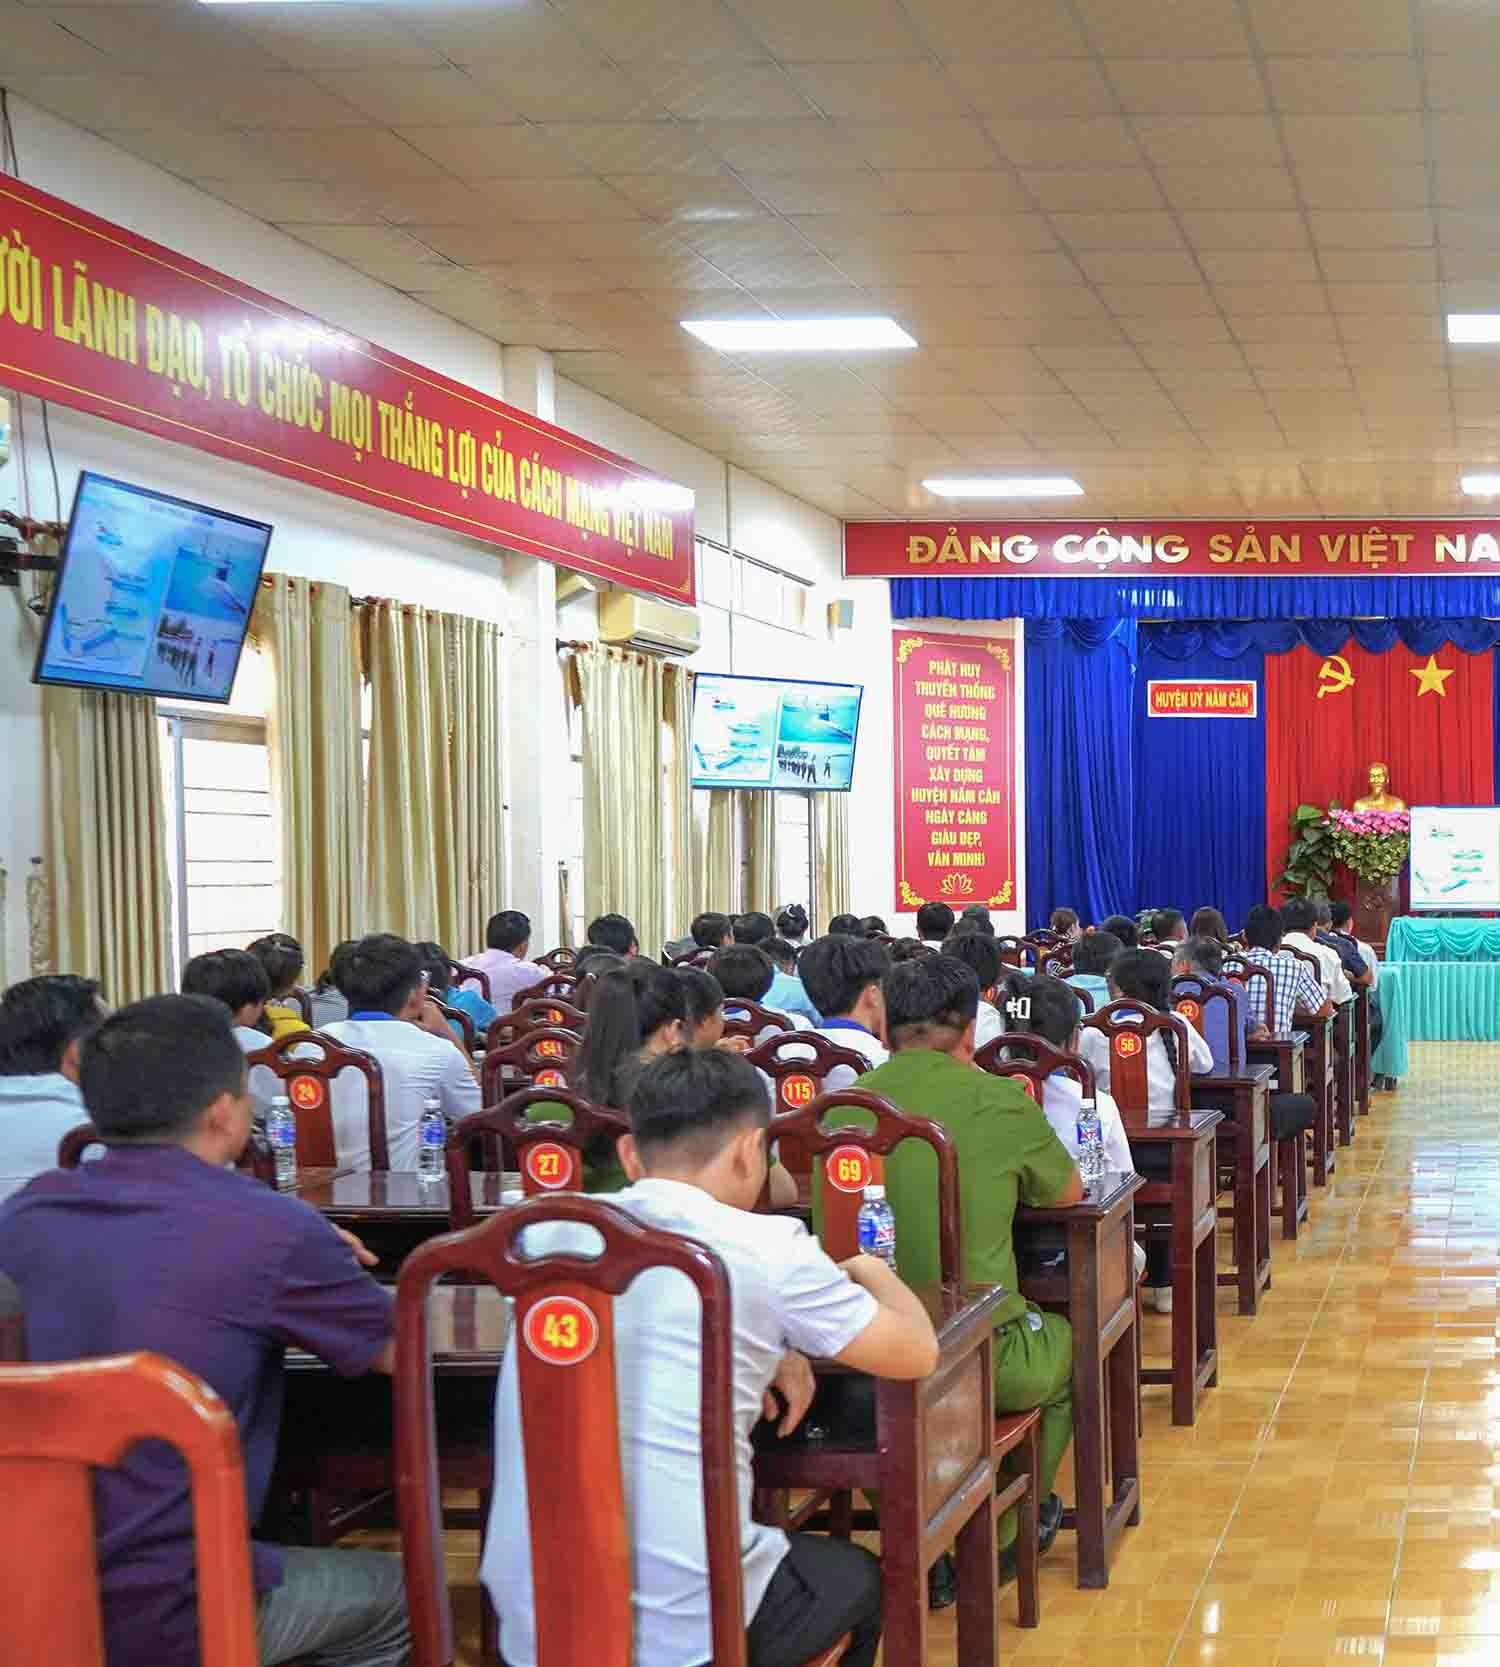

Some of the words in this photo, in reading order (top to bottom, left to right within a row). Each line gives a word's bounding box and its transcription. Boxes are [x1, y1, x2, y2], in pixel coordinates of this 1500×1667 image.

[53, 260, 138, 365] LÃNH
[146, 304, 210, 400] ĐẠO,
[256, 352, 323, 432] CHỨC
[330, 381, 373, 461] MỌI
[378, 392, 443, 477] THẮNG
[448, 428, 477, 498] LỢI
[482, 430, 516, 503] CỦA
[520, 453, 561, 519] CÁCH
[643, 509, 673, 561] NAM
[905, 524, 1039, 566] ĐẢNG
[1052, 526, 1191, 570] CỘNG
[1208, 524, 1301, 564] SẢN
[1319, 526, 1415, 570] VIỆT
[928, 658, 957, 677] PHÁT
[960, 663, 981, 679] HUY
[1155, 688, 1188, 711] HUYỆN
[1205, 688, 1227, 708] NĂM
[921, 721, 952, 740] CÁCH
[929, 764, 950, 782] XÂY
[786, 1082, 810, 1103] 115
[539, 1153, 560, 1176] 27
[838, 1158, 861, 1181] 69
[543, 1313, 578, 1349] 43
